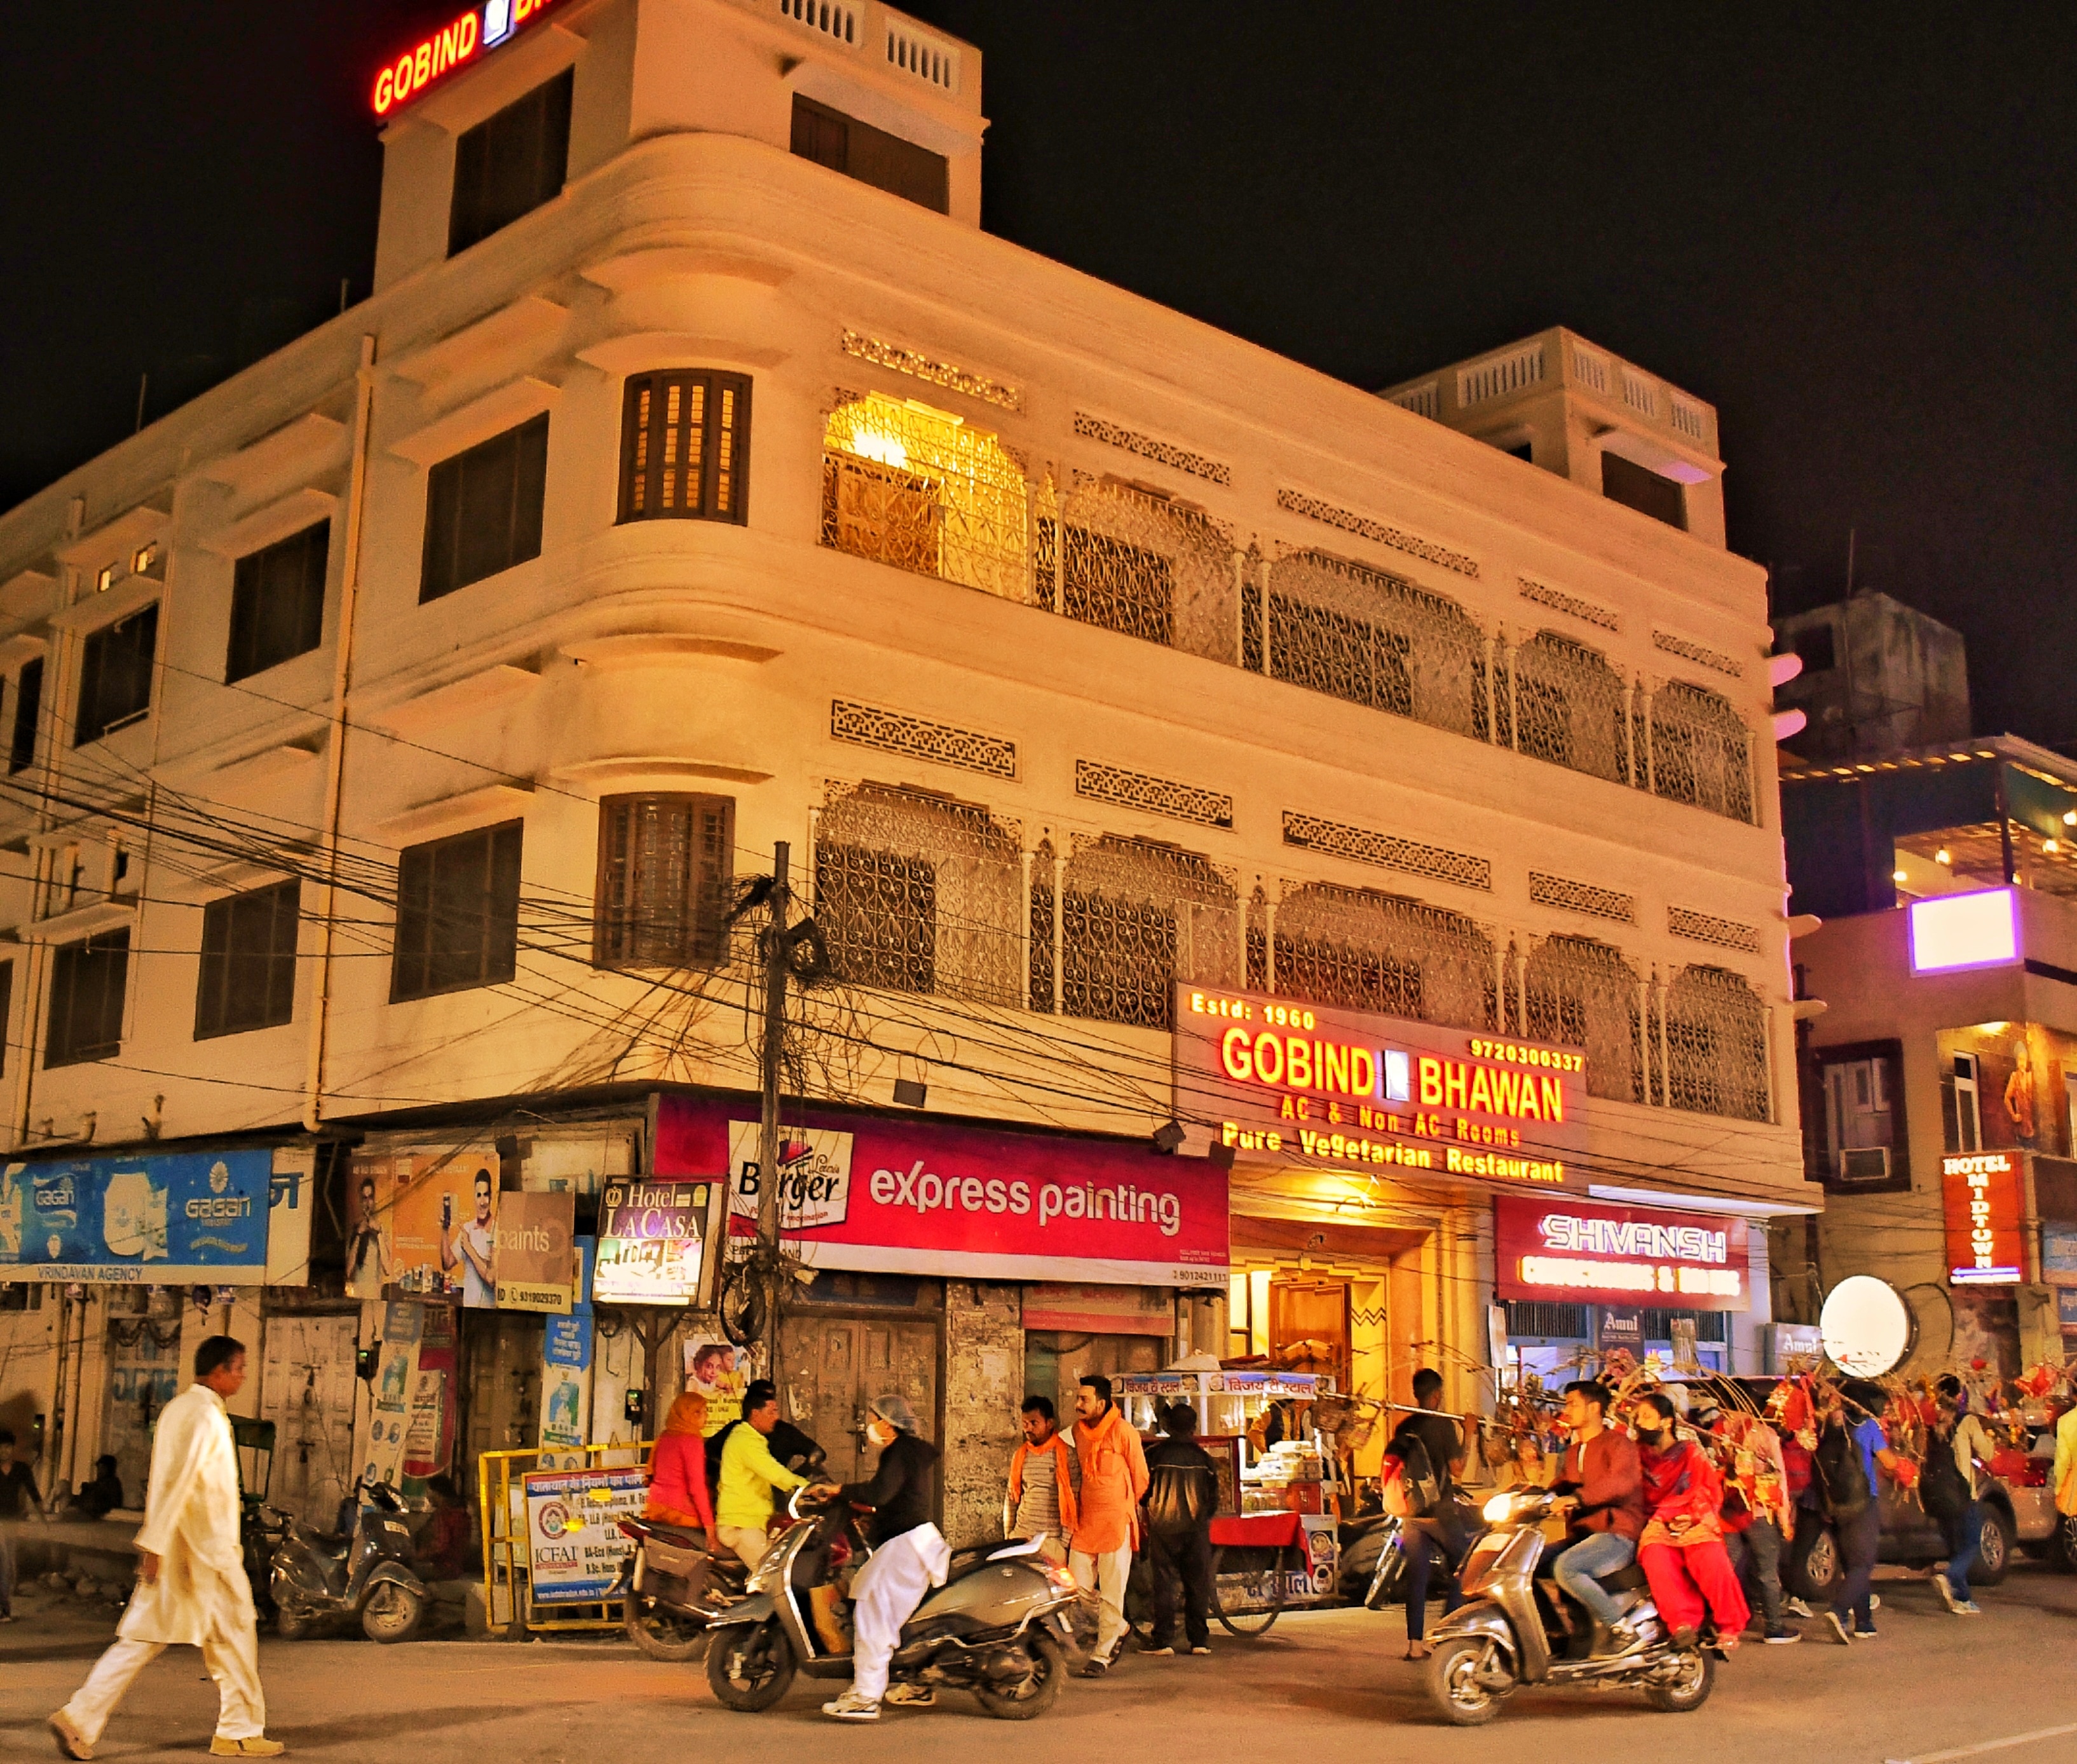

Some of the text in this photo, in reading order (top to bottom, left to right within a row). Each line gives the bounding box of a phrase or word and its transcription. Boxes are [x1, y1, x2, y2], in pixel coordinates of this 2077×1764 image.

[374, 11, 477, 114] GOBIND
[1190, 992, 1315, 1031] Estd: 1960
[1470, 1038, 1584, 1073] 9720300337
[1222, 1027, 1564, 1123] GOBIND BHAWAN
[1281, 1094, 1520, 1147] AC & Non AC Rooms
[1222, 1122, 1564, 1183] Pure Vegetarian Restaurant
[1942, 1155, 2012, 1175] HOTEL
[627, 1183, 676, 1208] Hotel
[739, 1160, 839, 1211] Brger
[869, 1160, 1181, 1237] express painting
[496, 1225, 550, 1252] paints
[1539, 1213, 1727, 1263] SHIVANSH
[37, 1266, 144, 1282] VRINDAVAN AGENCY
[1604, 1311, 1638, 1331] Amul
[1782, 1333, 1817, 1354] Amul
[1229, 1378, 1264, 1392] विजय
[535, 1545, 578, 1563] ICFAI
